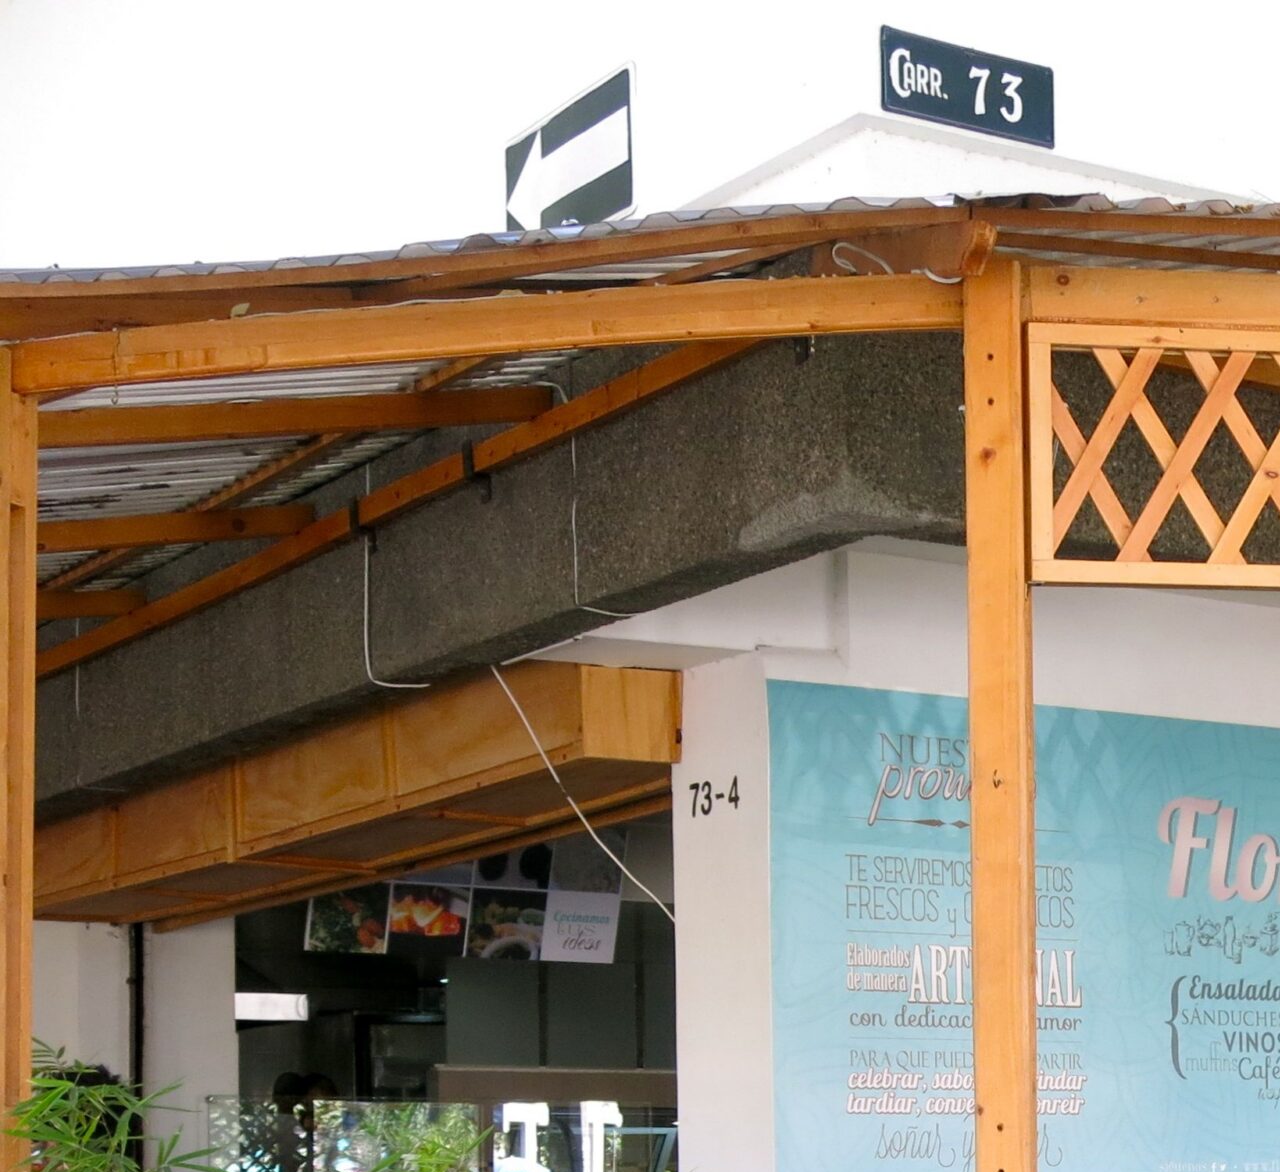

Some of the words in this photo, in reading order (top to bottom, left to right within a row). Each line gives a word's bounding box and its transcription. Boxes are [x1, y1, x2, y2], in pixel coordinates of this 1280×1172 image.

[968, 65, 1024, 123] 73
[689, 775, 740, 818] 73-4
[845, 853, 868, 882] TE
[846, 884, 939, 922] FRESCOS
[947, 907, 958, 938] y
[846, 943, 911, 968] Elaborados
[847, 967, 862, 991] de
[864, 972, 908, 992] manera
[849, 1012, 887, 1028] con
[850, 1049, 892, 1067] PARA
[896, 1050, 929, 1071] QUE
[1185, 1040, 1239, 1073] muffins
[874, 1121, 956, 1168] soñar
